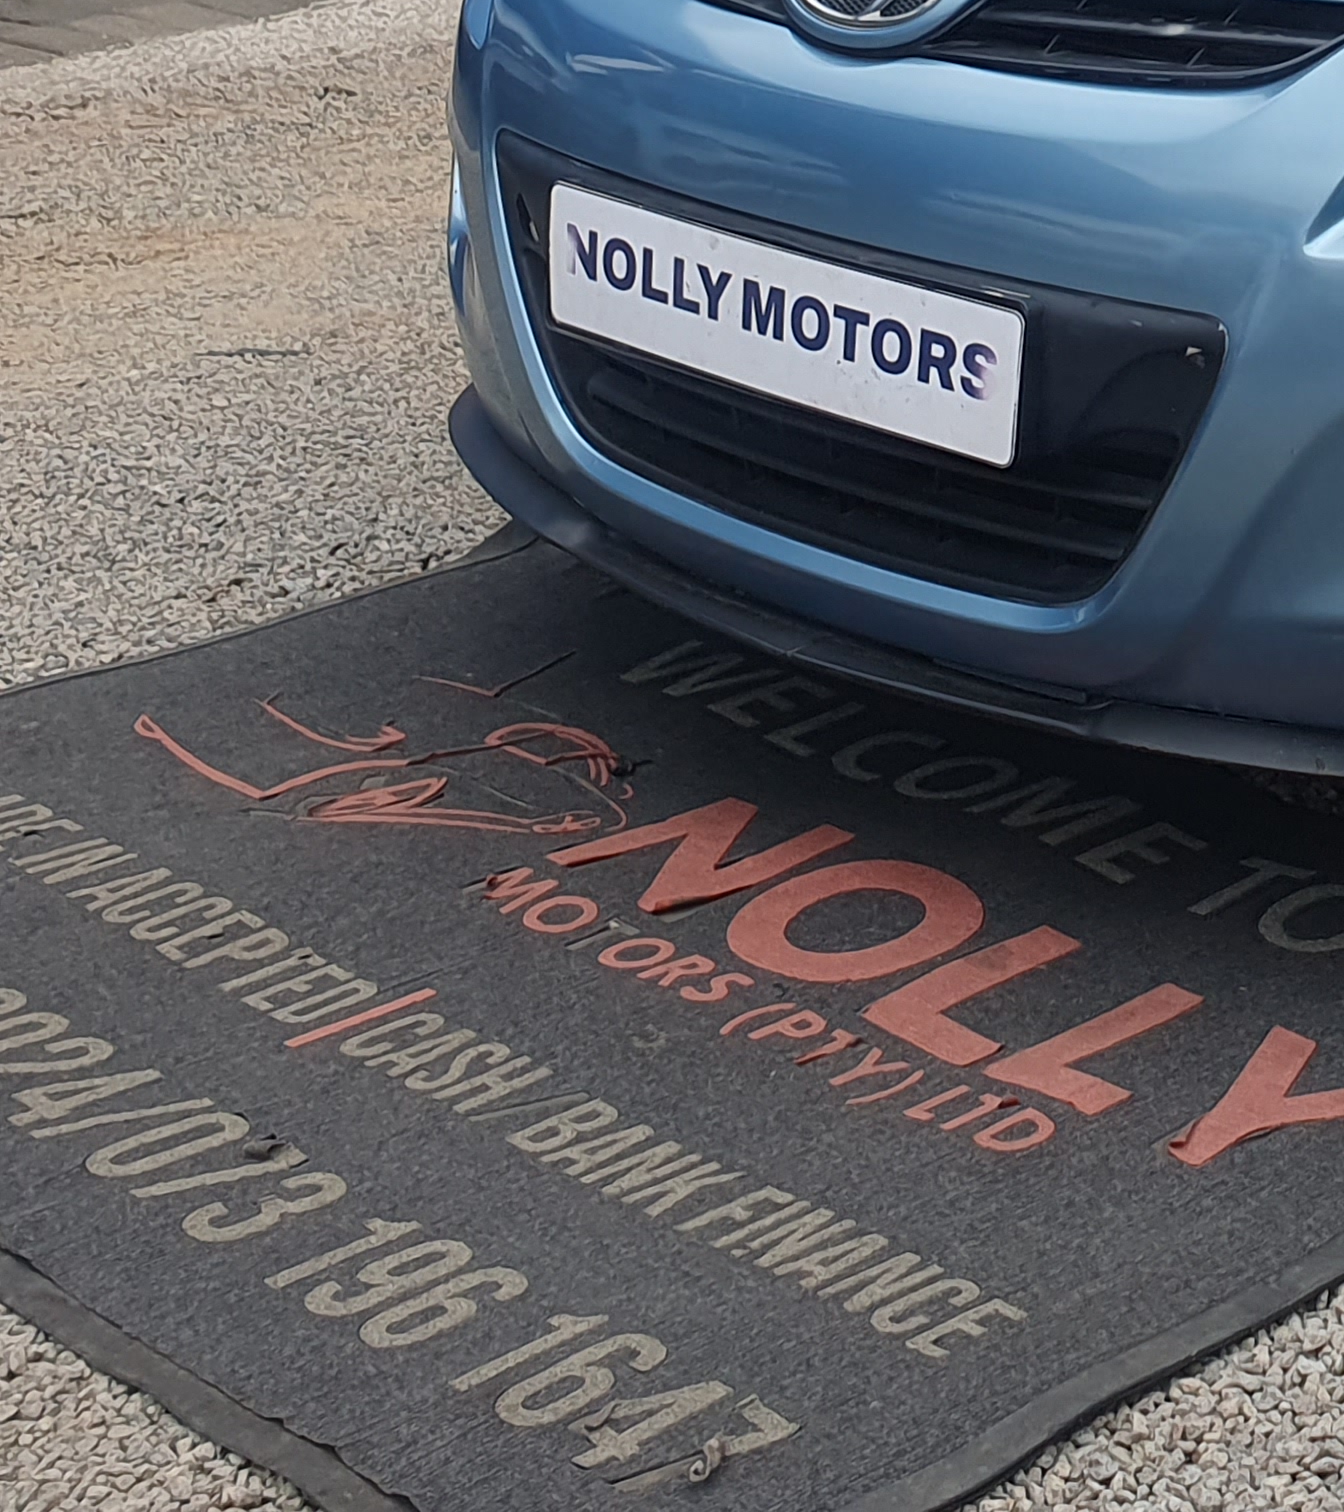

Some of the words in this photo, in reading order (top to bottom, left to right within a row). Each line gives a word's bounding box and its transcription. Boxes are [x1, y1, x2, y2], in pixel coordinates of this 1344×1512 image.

[566, 223, 732, 321] NOLLY
[741, 278, 998, 401] MOTORS
[619, 639, 1208, 884] WELCOME
[8, 837, 138, 885] IN
[674, 1185, 1029, 1360] FINANCE
[902, 1084, 1056, 1152] LTD
[264, 1218, 528, 1348] 196
[449, 1314, 802, 1492] 1647
